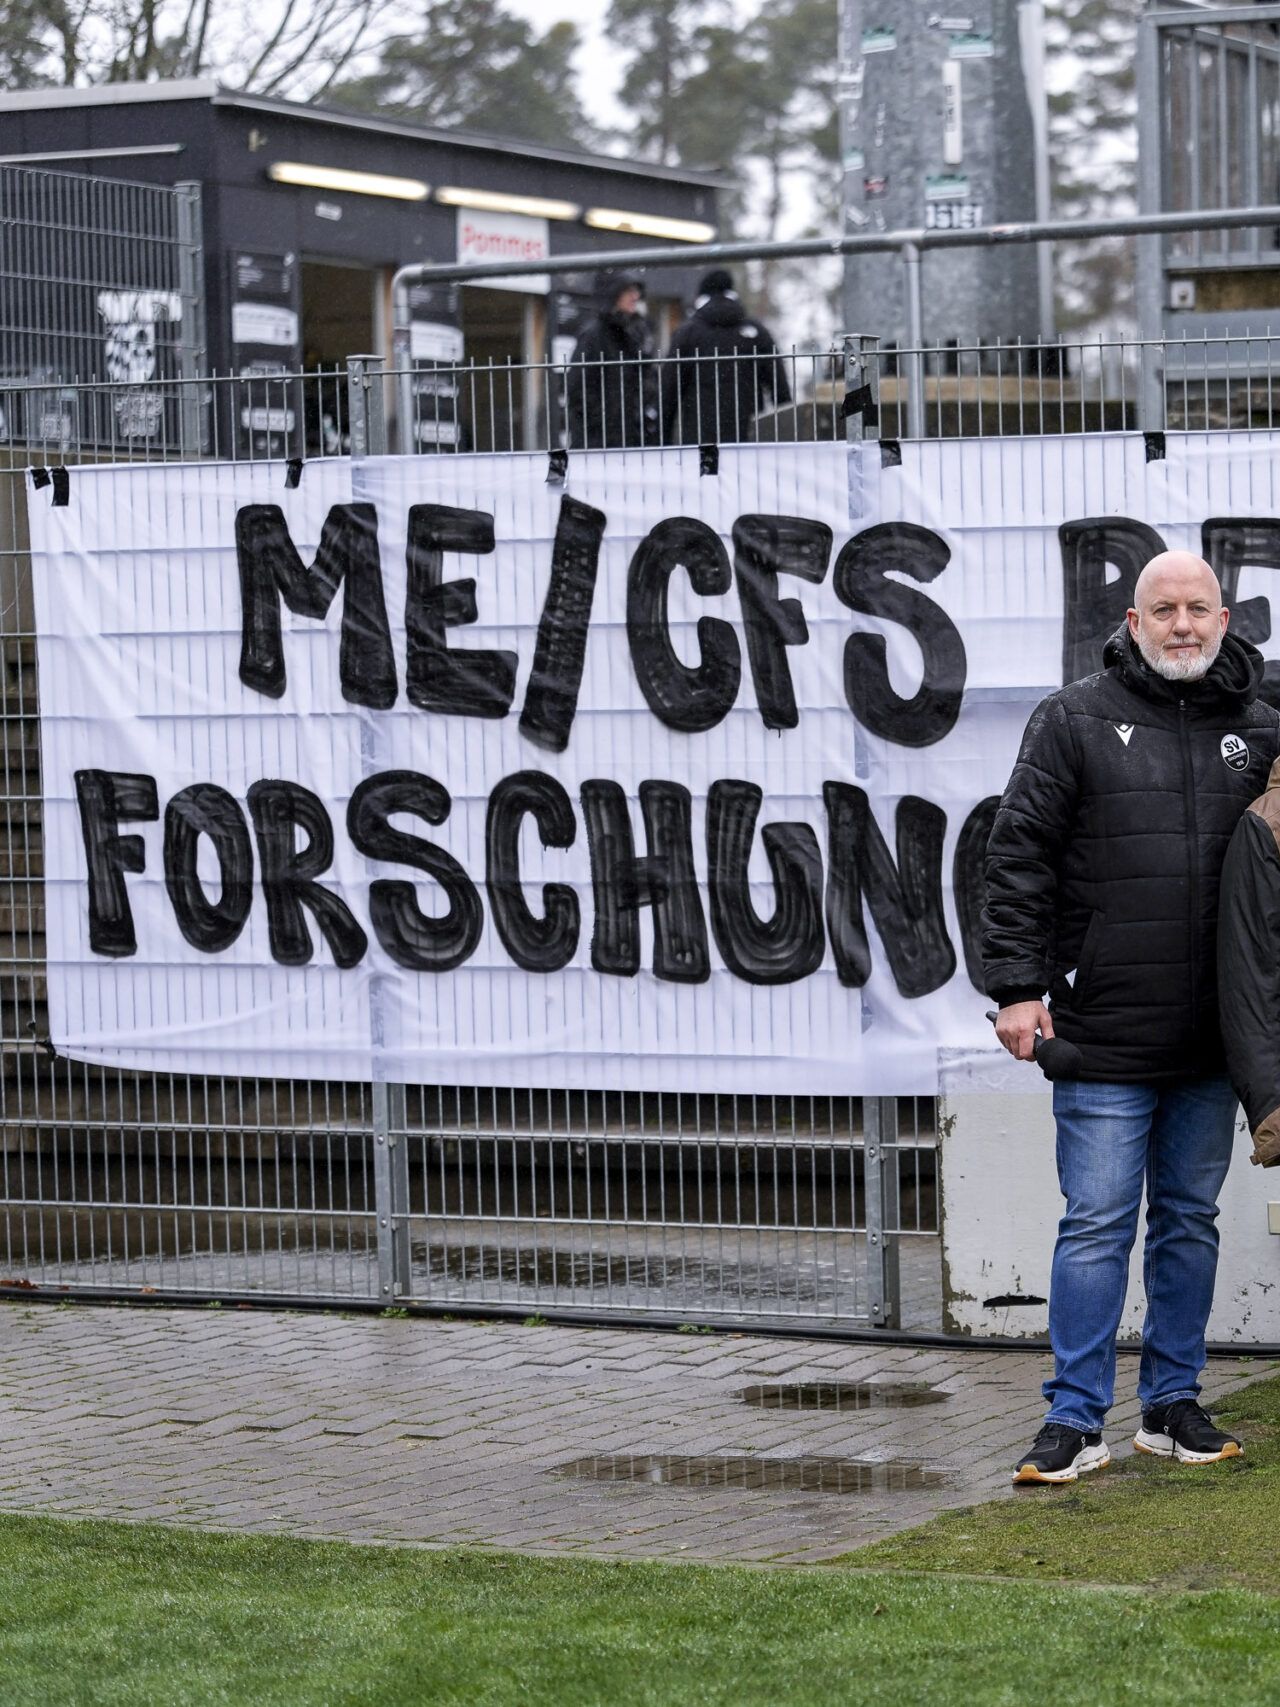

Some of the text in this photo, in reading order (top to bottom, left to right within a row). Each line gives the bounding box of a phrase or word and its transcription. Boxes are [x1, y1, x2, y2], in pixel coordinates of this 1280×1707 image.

[462, 224, 545, 260] Pommes
[236, 493, 967, 748] ME/CFS
[1224, 738, 1240, 753] SV
